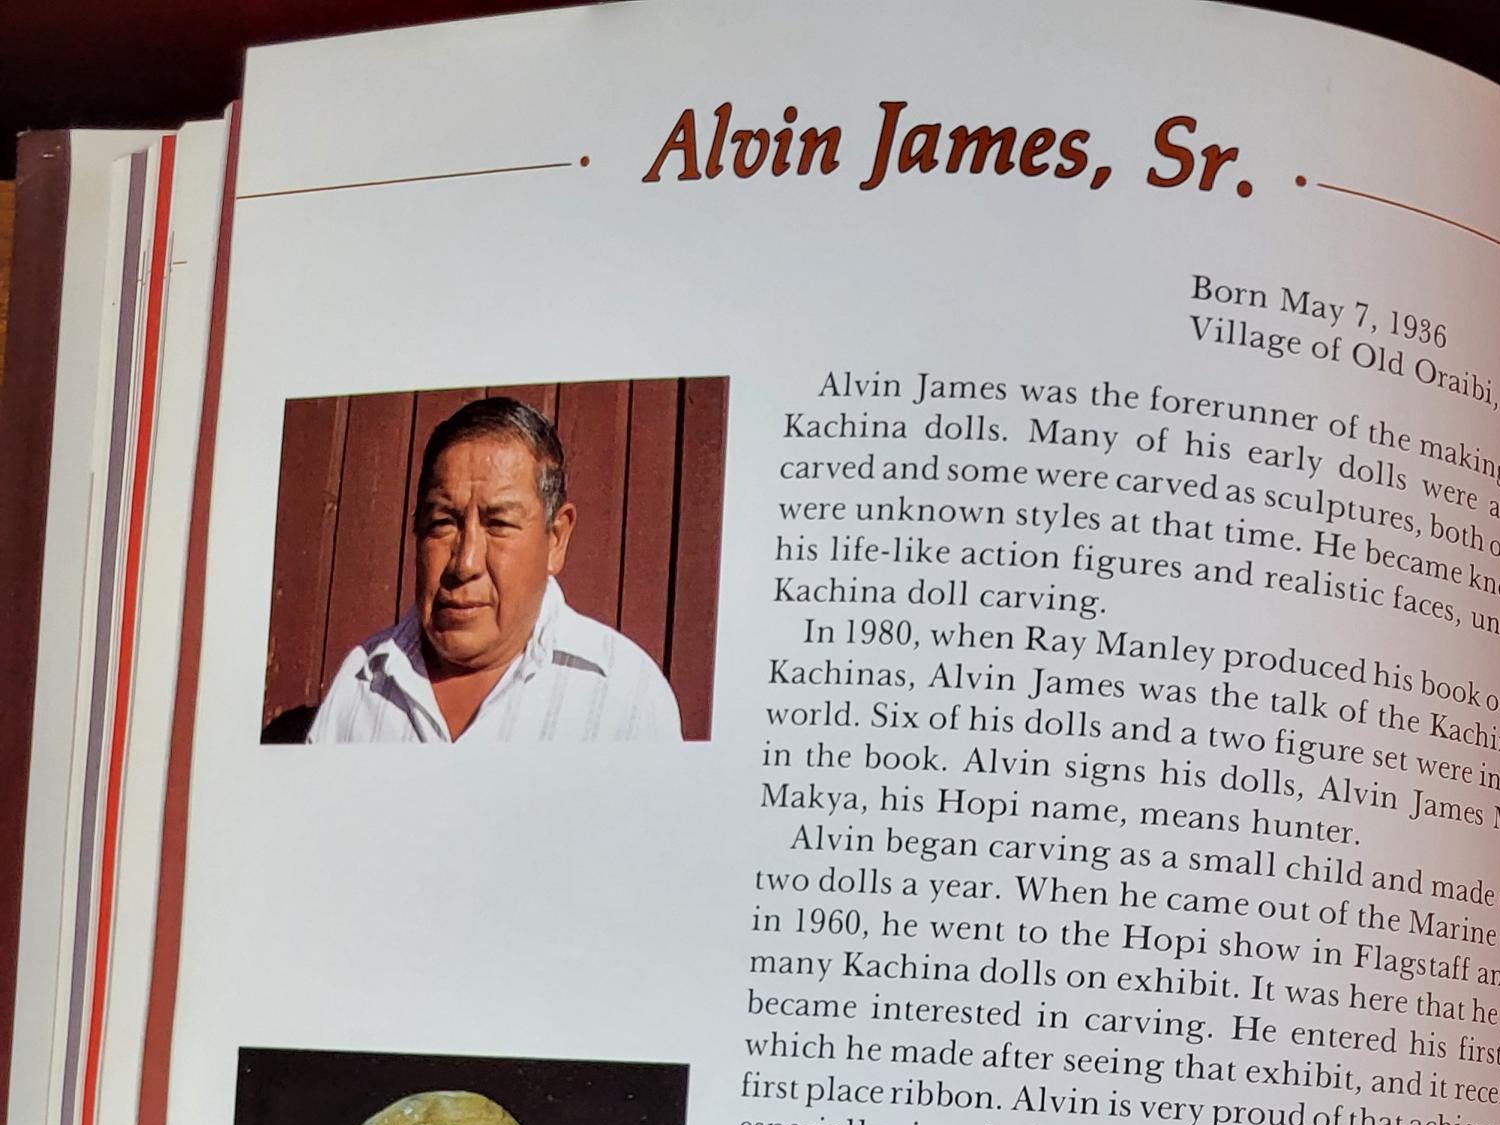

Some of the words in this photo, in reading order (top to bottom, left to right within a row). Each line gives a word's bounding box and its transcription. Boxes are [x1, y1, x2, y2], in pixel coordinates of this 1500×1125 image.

[641, 102, 842, 184] Alvin
[859, 100, 1112, 192] James,
[1146, 114, 1254, 199] Sr.
[1190, 274, 1269, 308] Born
[1279, 287, 1345, 328] May
[1354, 300, 1379, 334] 7,
[1390, 310, 1449, 350] 1936
[1188, 314, 1303, 359] Village
[1310, 336, 1343, 363] of
[1351, 341, 1406, 377] Old
[1414, 357, 1499, 413] Oraibi,
[817, 370, 901, 398] Alvin
[911, 372, 1008, 406] James
[1019, 383, 1078, 405] was
[1091, 380, 1140, 410] the
[1149, 384, 1319, 432] forerunner
[1328, 413, 1360, 440] of
[1368, 420, 1411, 452] the
[773, 576, 897, 605] Kachina
[907, 577, 968, 607] doll
[979, 583, 1106, 621] carving.
[768, 658, 915, 692] Kachinas,
[927, 661, 1016, 692] Alvin
[1027, 667, 1125, 701] James
[1138, 682, 1197, 705] was
[1211, 681, 1259, 711] the
[1271, 689, 1328, 719] talk
[1338, 698, 1370, 725] of
[1378, 703, 1420, 734] the
[760, 782, 868, 817] Makya,
[879, 784, 925, 813] his
[936, 787, 1019, 824] Hopi
[1031, 800, 1127, 828] name,
[1139, 807, 1240, 833] means
[1251, 808, 1360, 846] hunter.
[755, 870, 810, 892] two
[818, 865, 893, 895] dolls
[901, 877, 918, 897] a
[929, 879, 1001, 904] year.
[1014, 875, 1108, 906] When
[1119, 880, 1158, 909] he
[1166, 892, 1250, 917] came
[1257, 900, 1311, 922] out
[1318, 899, 1350, 926] of
[1358, 903, 1401, 932] the
[1408, 909, 1497, 947] Marine
[747, 987, 858, 1019] became
[871, 992, 1021, 1027] interested
[1036, 1000, 1069, 1030] in
[1084, 1008, 1213, 1045] carving.
[1231, 1014, 1277, 1043] He
[1290, 1026, 1397, 1054] entered
[1408, 1029, 1447, 1059] his
